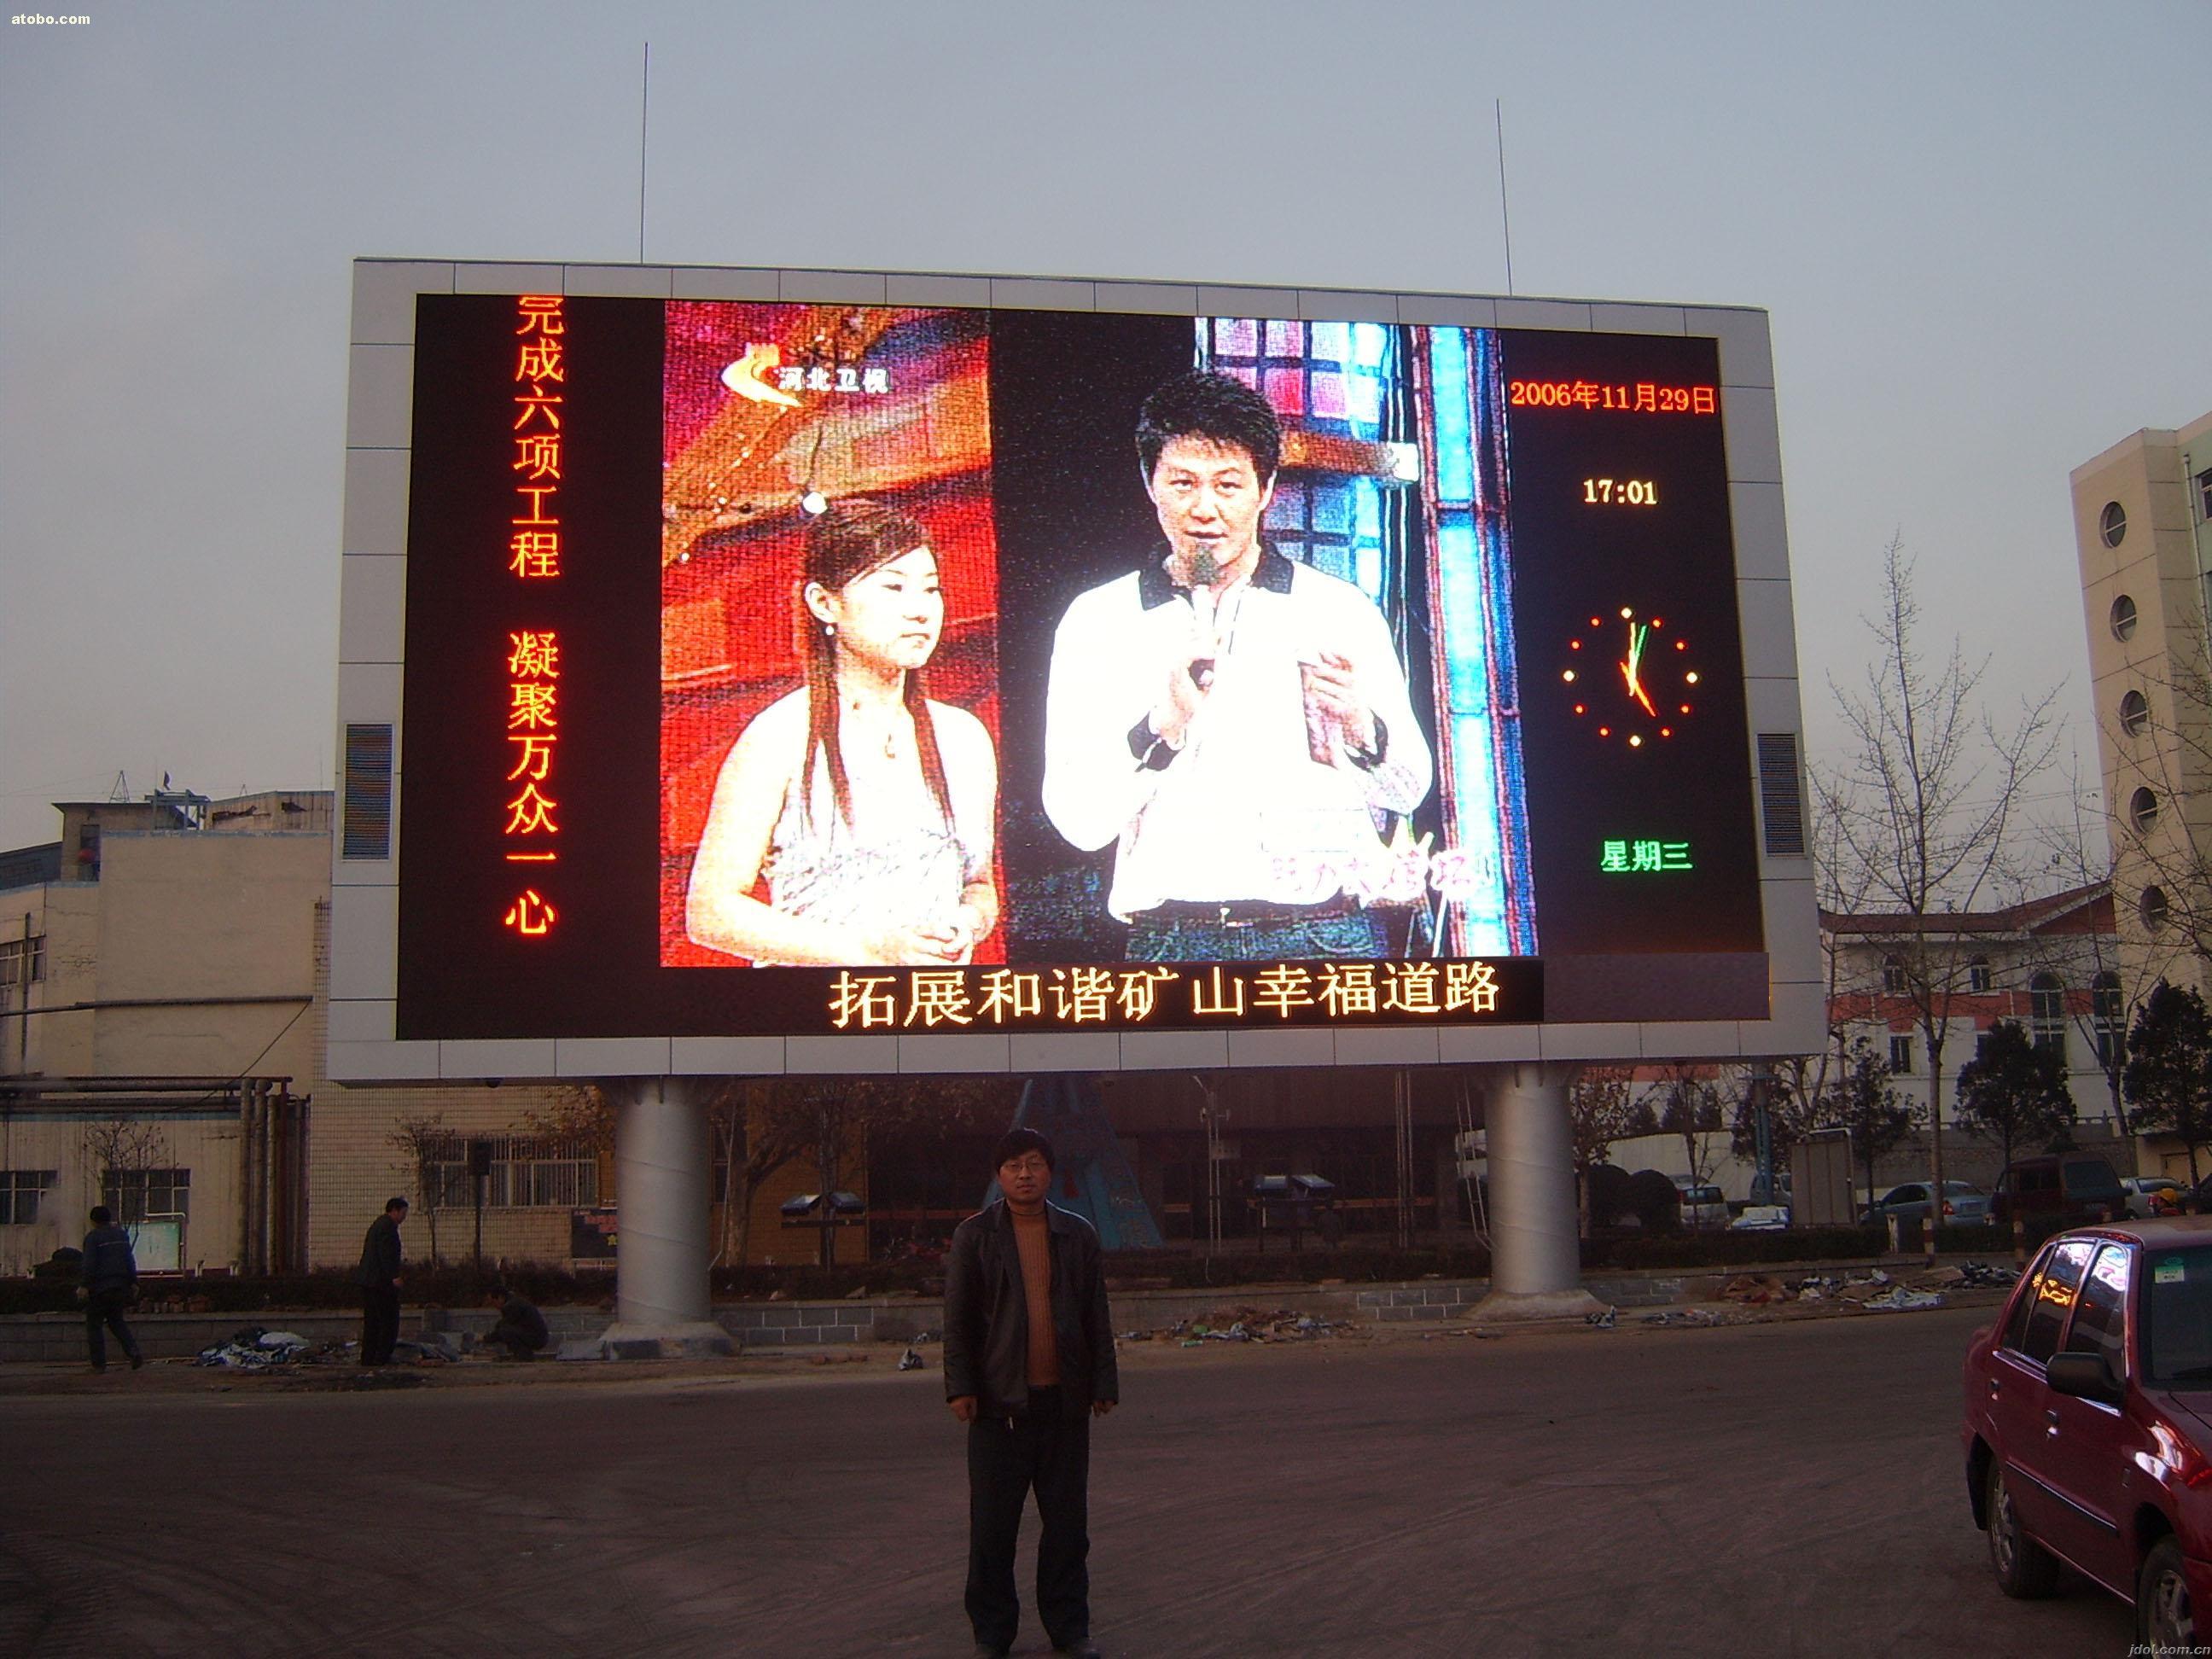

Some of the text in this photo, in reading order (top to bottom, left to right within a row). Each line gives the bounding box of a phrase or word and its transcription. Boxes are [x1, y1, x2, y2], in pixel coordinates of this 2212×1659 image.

[778, 367, 888, 393] 河北卫视
[1511, 381, 1714, 414] 2006年11月29日
[1583, 479, 1657, 504] 17:01
[505, 294, 565, 935] 完成六项工程 凝聚万众一心
[1600, 840, 1693, 872] 星期三
[828, 962, 1499, 1029] 拓展和谐矿山幸福道路
